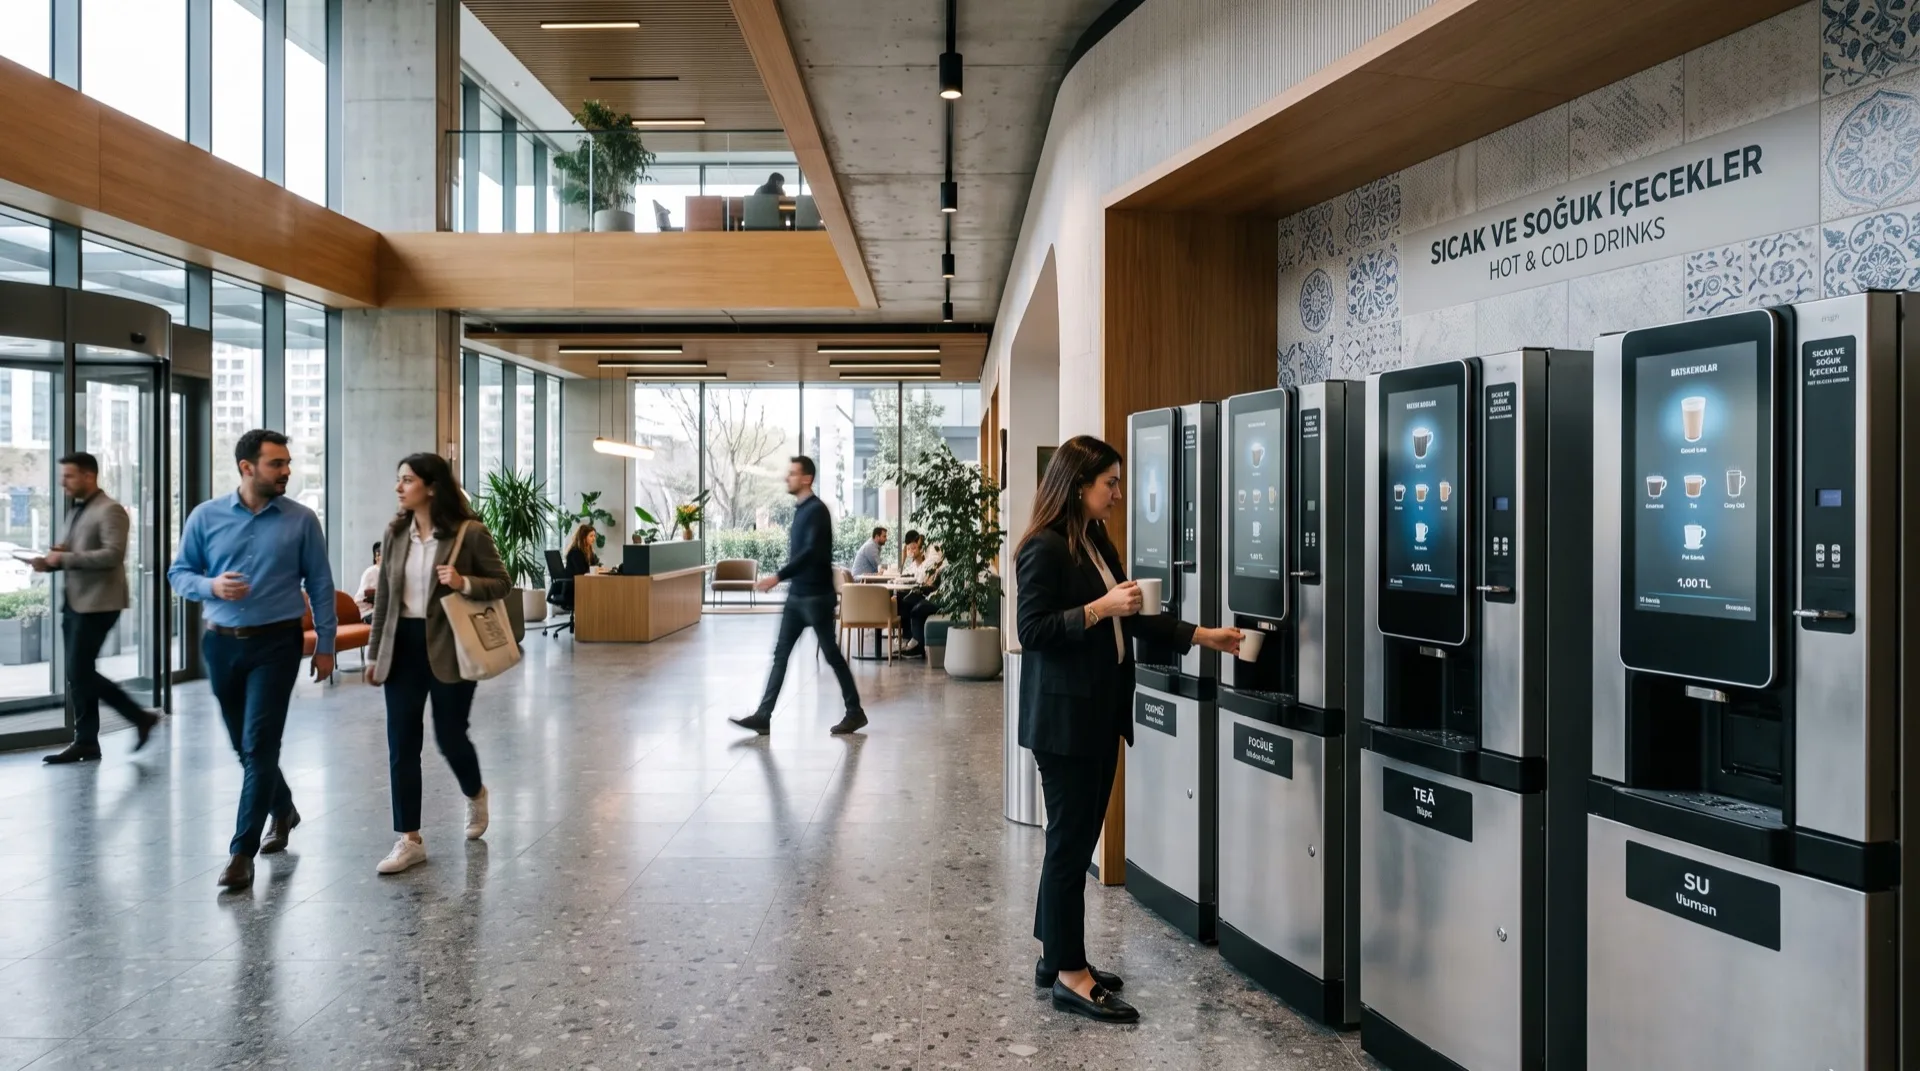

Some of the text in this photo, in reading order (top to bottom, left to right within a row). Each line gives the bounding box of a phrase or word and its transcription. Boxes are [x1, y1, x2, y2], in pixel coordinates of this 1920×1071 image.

[1430, 144, 1763, 265] SICAK VE SOĞUK İÇECEKLER
[1490, 216, 1666, 280] HOT & COLD DRINKS
[1812, 347, 1845, 358] SICAK VE
[1424, 564, 1432, 572] TL
[1677, 577, 1711, 589] 1,00 TL
[1684, 873, 1710, 895] SU
